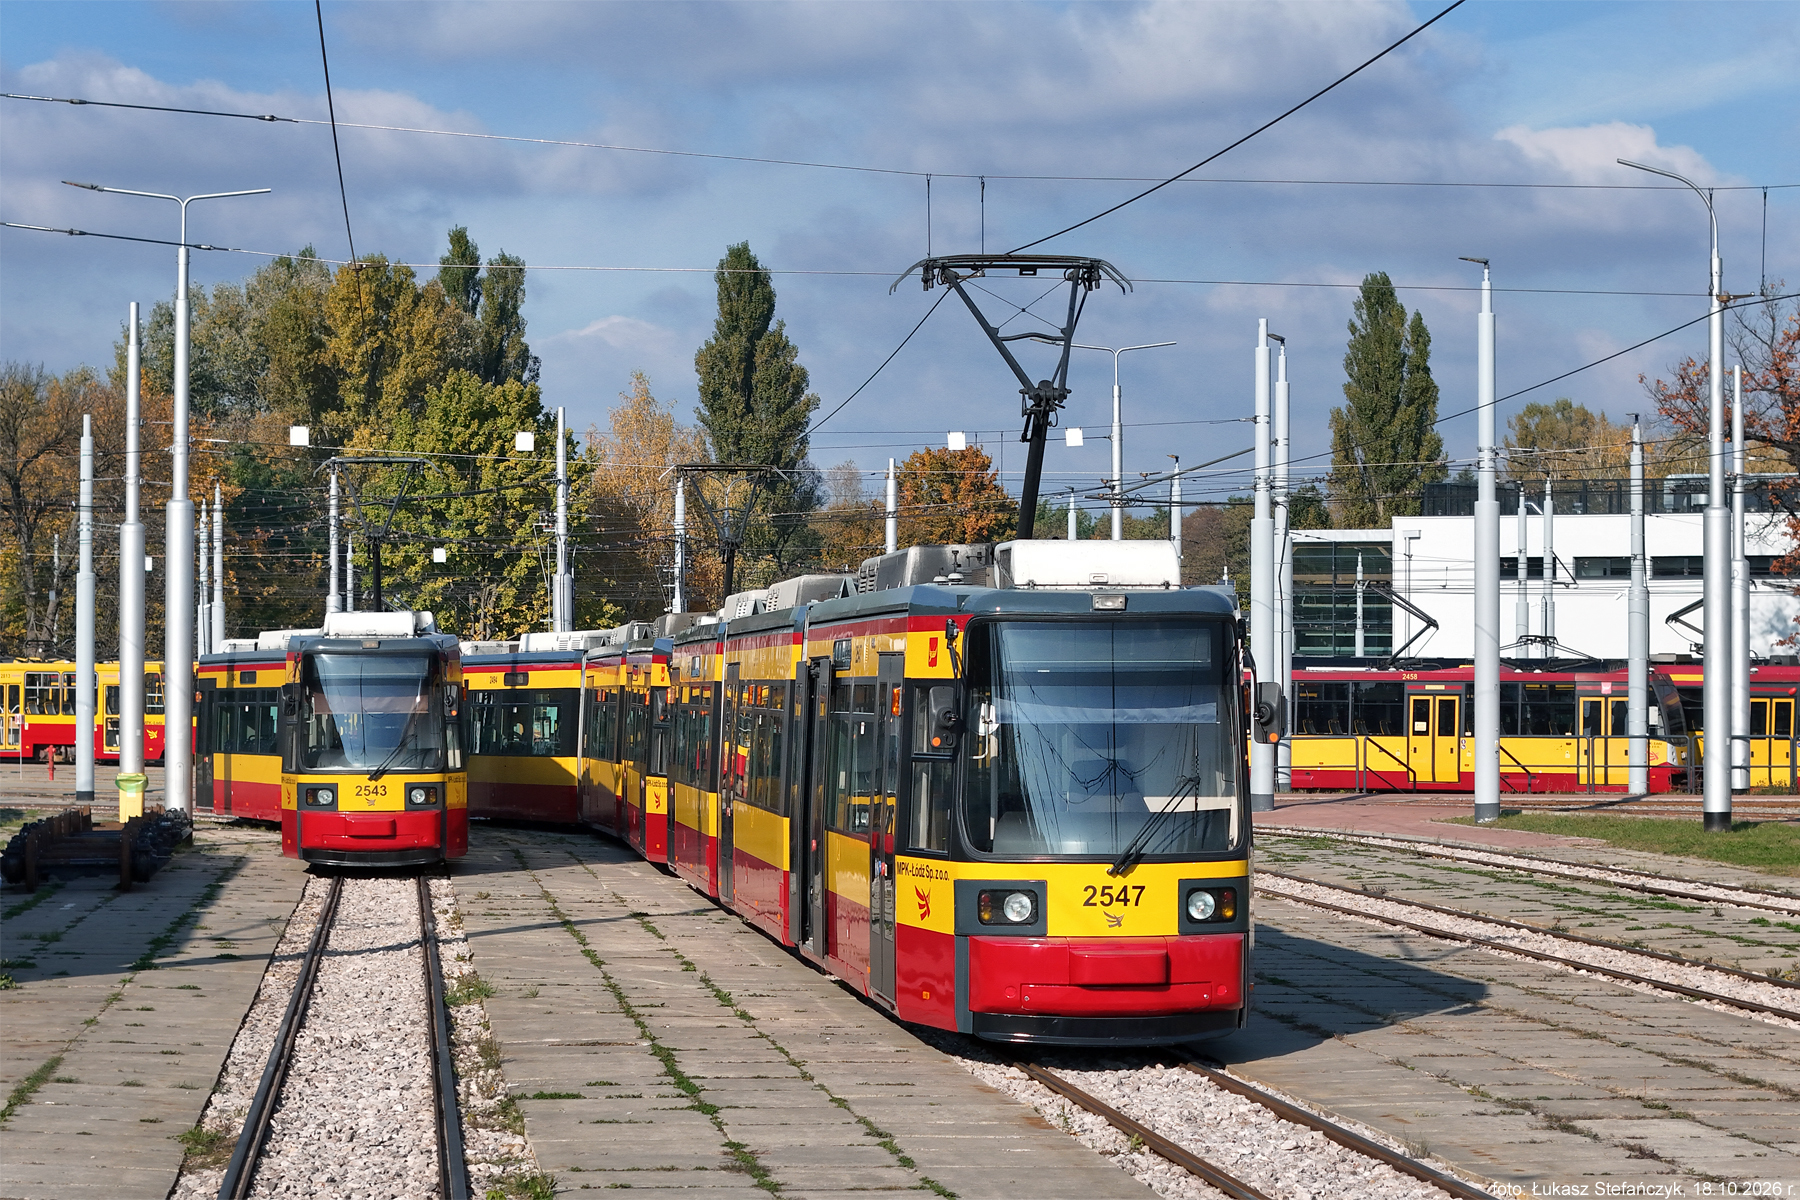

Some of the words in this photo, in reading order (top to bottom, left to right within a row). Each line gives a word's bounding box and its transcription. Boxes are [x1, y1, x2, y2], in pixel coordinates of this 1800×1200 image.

[355, 785, 387, 796] 2543
[925, 864, 934, 882] Sp.
[1083, 885, 1146, 907] 2547
